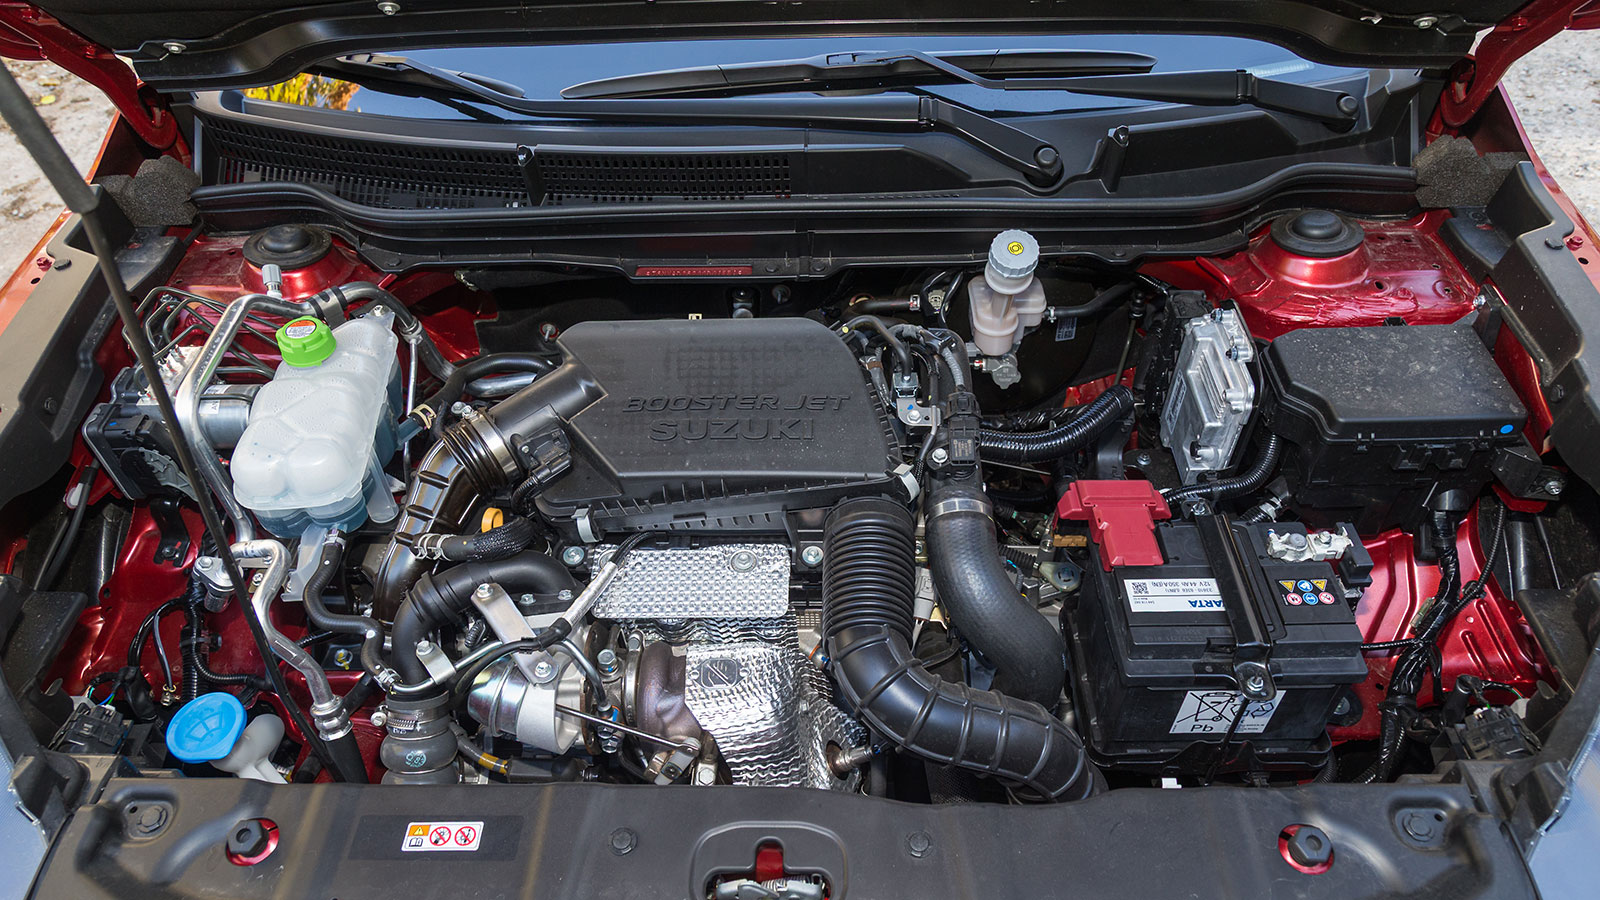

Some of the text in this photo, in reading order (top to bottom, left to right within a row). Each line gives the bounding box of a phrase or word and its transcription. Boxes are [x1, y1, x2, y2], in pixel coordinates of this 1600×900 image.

[648, 417, 815, 442] SUZUKI
[1188, 600, 1224, 608] ARTA
[1190, 724, 1214, 733] Pb
